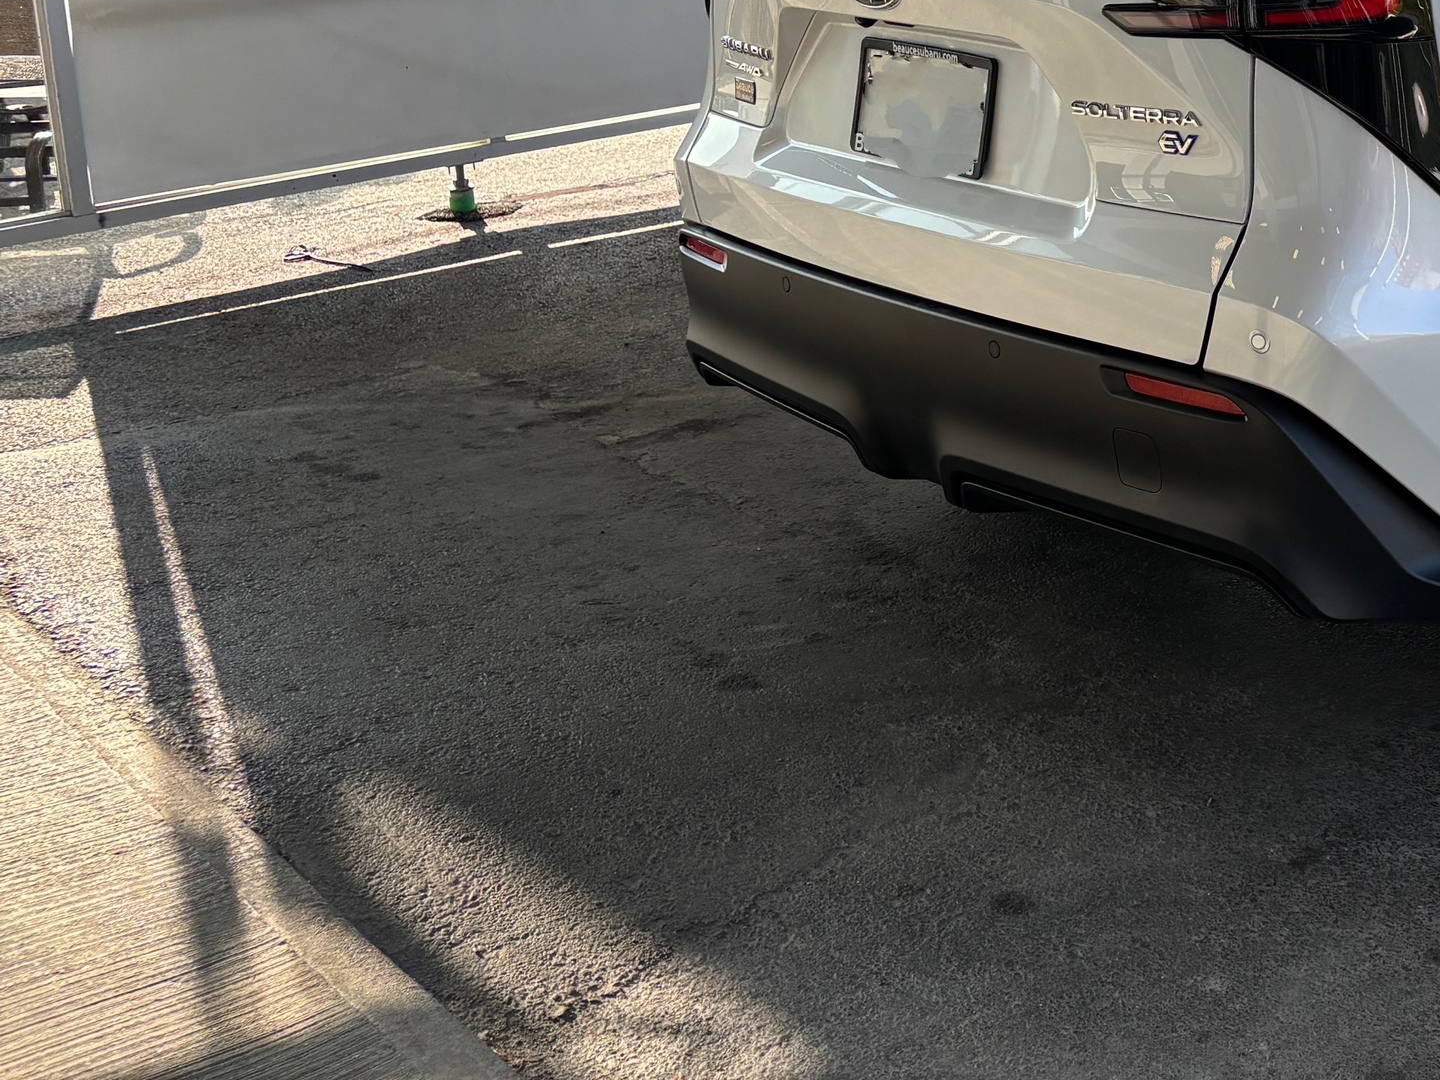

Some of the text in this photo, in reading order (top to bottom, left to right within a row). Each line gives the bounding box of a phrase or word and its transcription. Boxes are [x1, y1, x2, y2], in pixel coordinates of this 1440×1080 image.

[721, 35, 773, 61] SUBARU
[892, 41, 960, 63] beaucesubaru.com
[1071, 99, 1203, 128] SOLTERRA
[1158, 130, 1199, 156] EV
